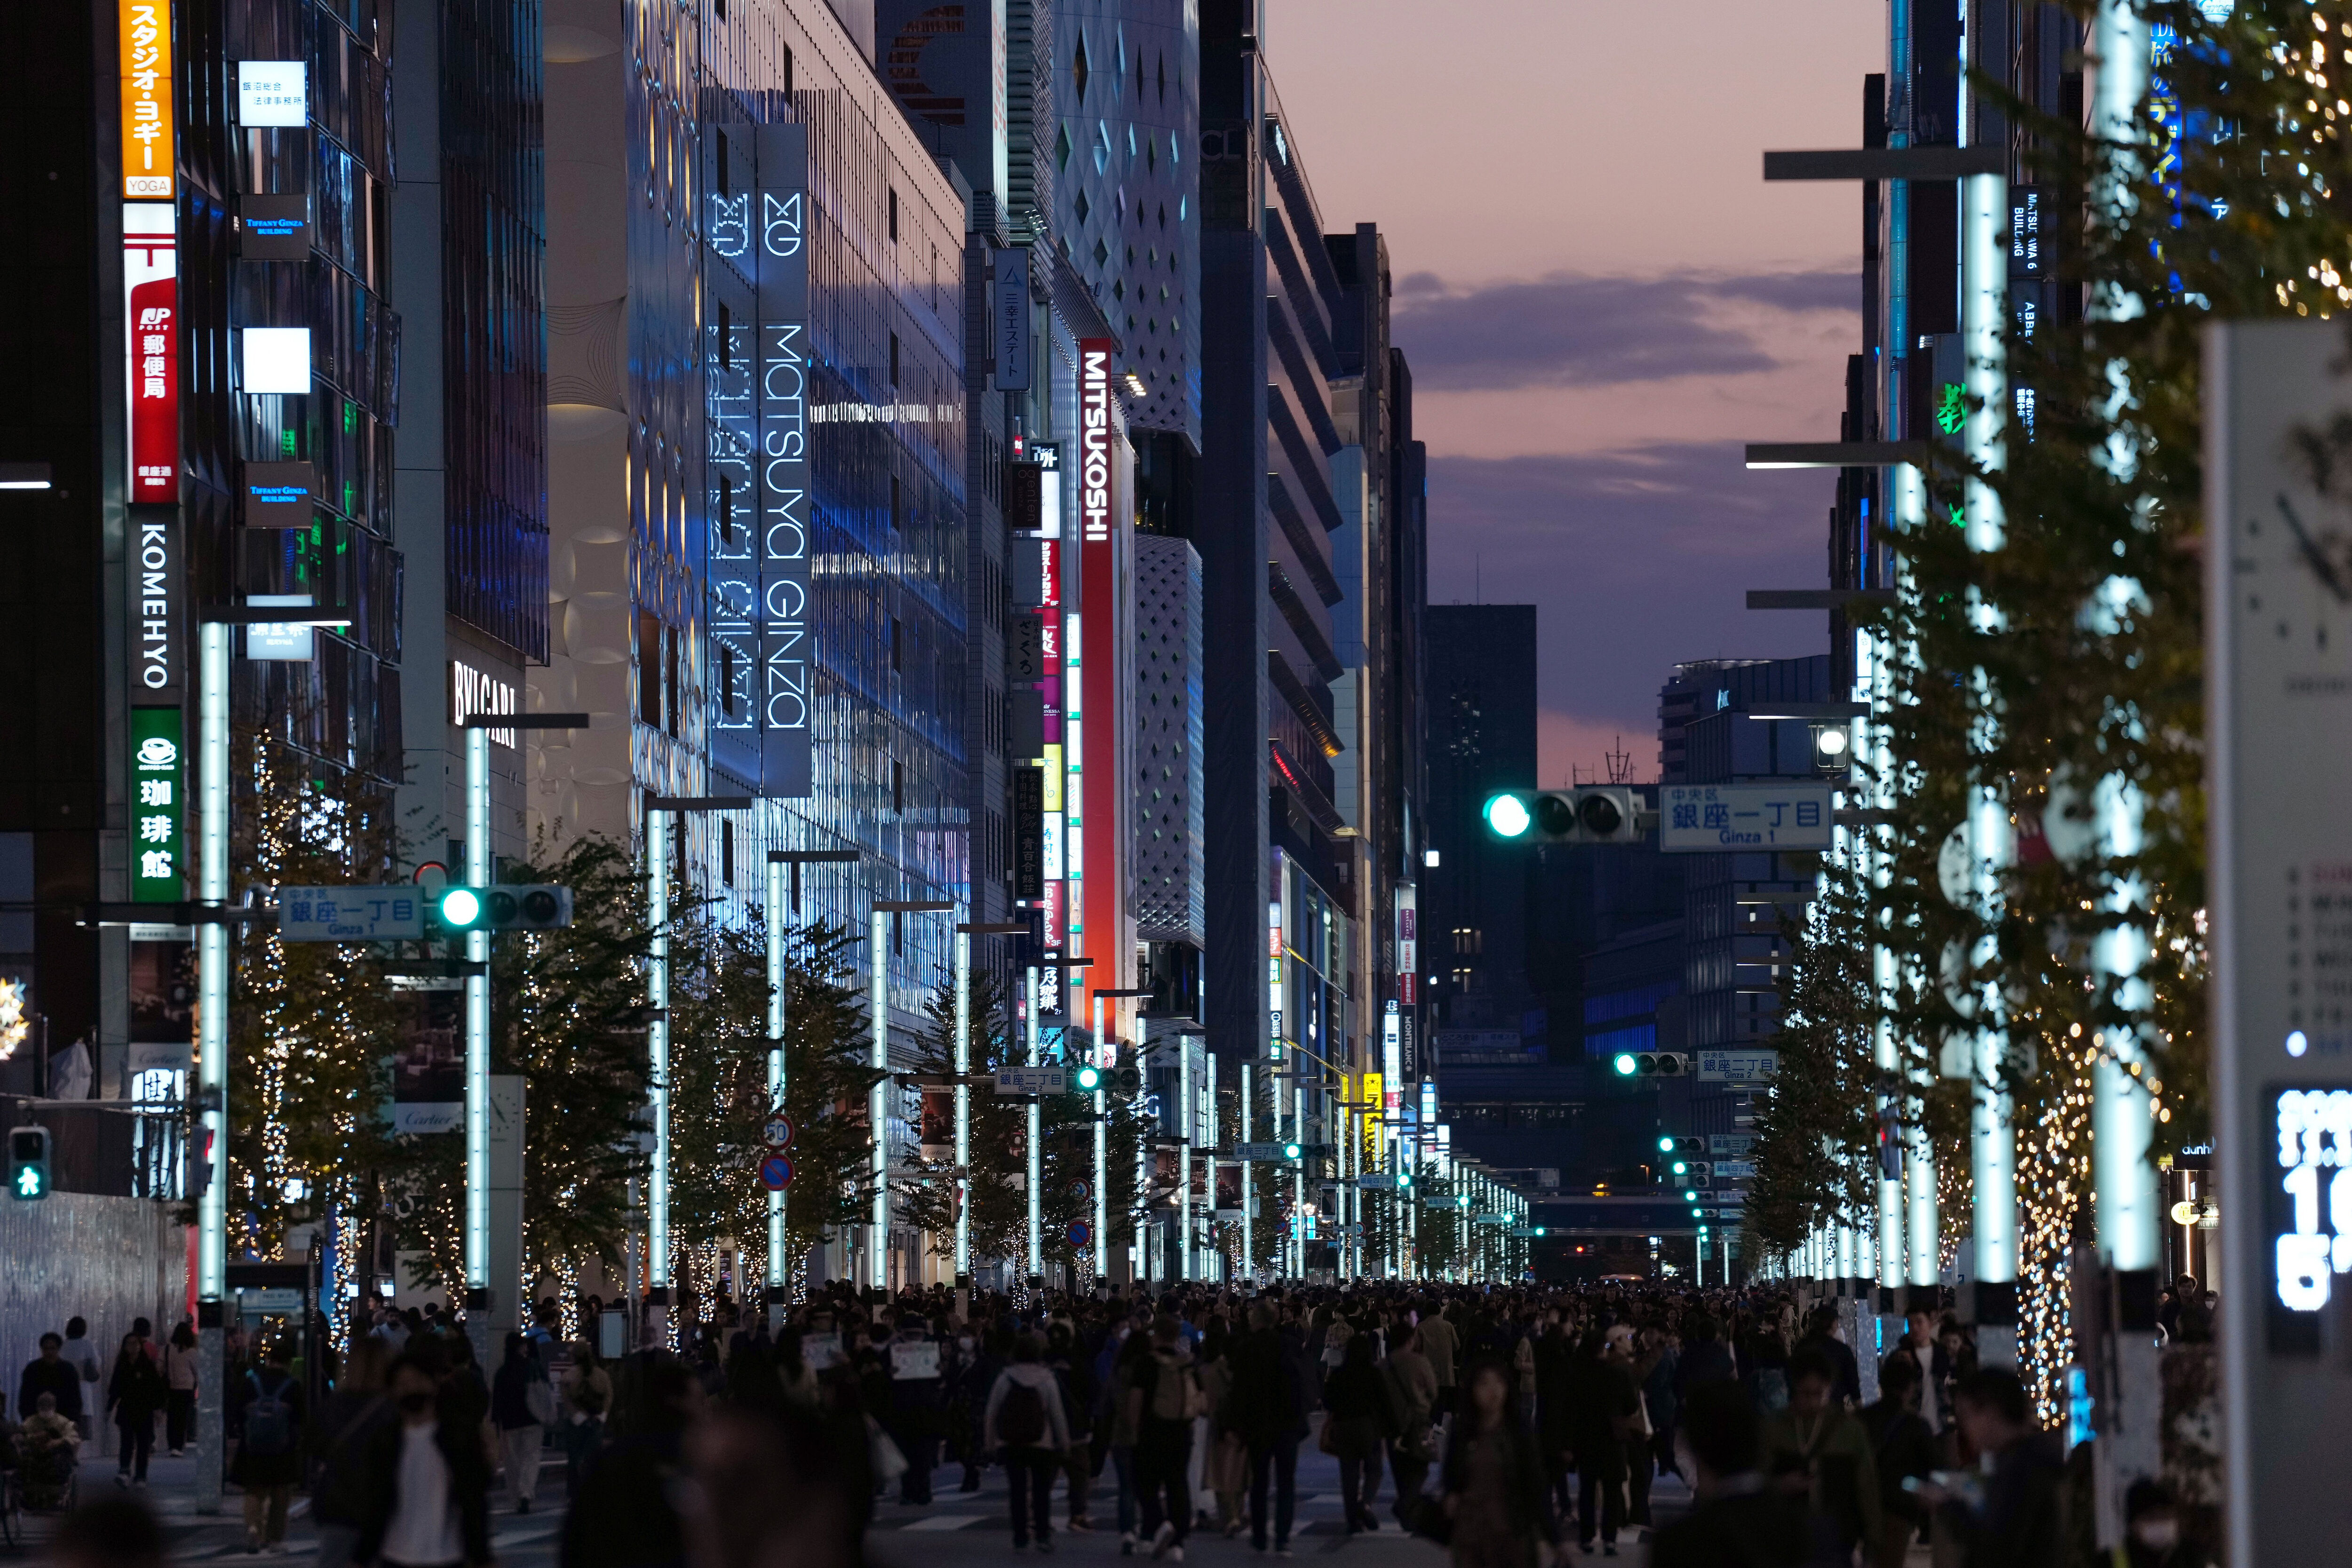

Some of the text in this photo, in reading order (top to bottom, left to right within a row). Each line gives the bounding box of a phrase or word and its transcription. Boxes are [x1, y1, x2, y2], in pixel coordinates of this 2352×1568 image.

[131, 5, 161, 170] スタジオ・ヨギー
[243, 81, 281, 91] 飯沼総合
[253, 96, 302, 106] 法律事務所
[129, 180, 167, 192] YOGA
[2027, 194, 2037, 259] MATSUAWA
[141, 308, 171, 325] JP
[1005, 294, 1018, 377] 三幸エステート
[143, 334, 166, 398] 郵便局
[1085, 352, 1107, 541] MITSUKOSHI
[138, 465, 172, 477] 銀座通
[250, 486, 308, 494] TIFFANY GINZA
[142, 523, 168, 689] KOMEHYO
[766, 579, 805, 729] GINZA
[1019, 620, 1033, 675] ざくろ
[1672, 788, 1719, 800] 中央区
[1673, 801, 1820, 830] 銀座一丁目
[141, 779, 172, 878] 珈琲館
[1719, 829, 1776, 844] Ginza 1
[1021, 837, 1036, 894] 青百合飯荘
[290, 900, 413, 922] 銀座一丁目
[1042, 887, 1054, 944] おたからや
[329, 923, 375, 935] Ginza 1
[1271, 1012, 1281, 1038] Oasis
[1703, 1059, 1772, 1072] 銀座二丁目
[1000, 1074, 1061, 1085] 銀座二丁目
[405, 1112, 453, 1126] Cartier
